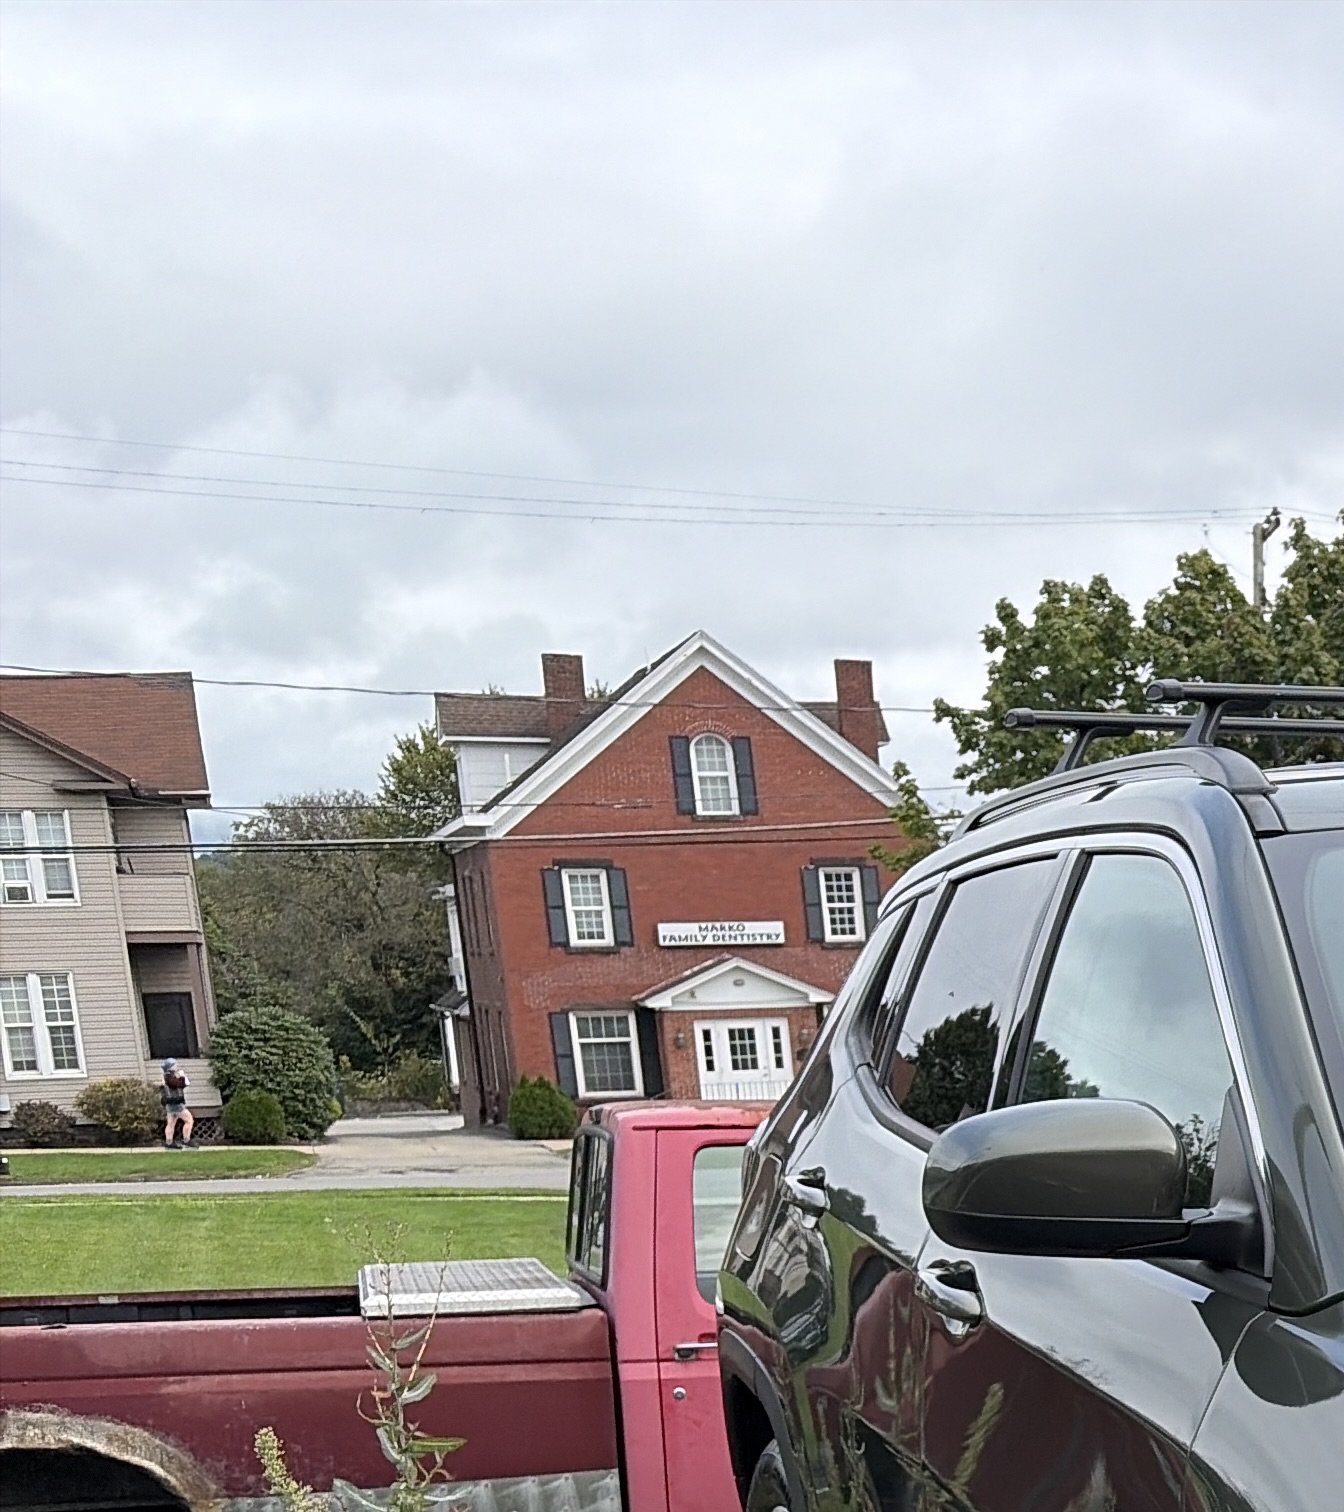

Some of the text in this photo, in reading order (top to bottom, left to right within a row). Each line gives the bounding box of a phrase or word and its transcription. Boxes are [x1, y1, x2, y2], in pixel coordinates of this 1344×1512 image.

[698, 923, 746, 933] MARKO
[661, 932, 781, 943] FAMILY DENTISTRY
